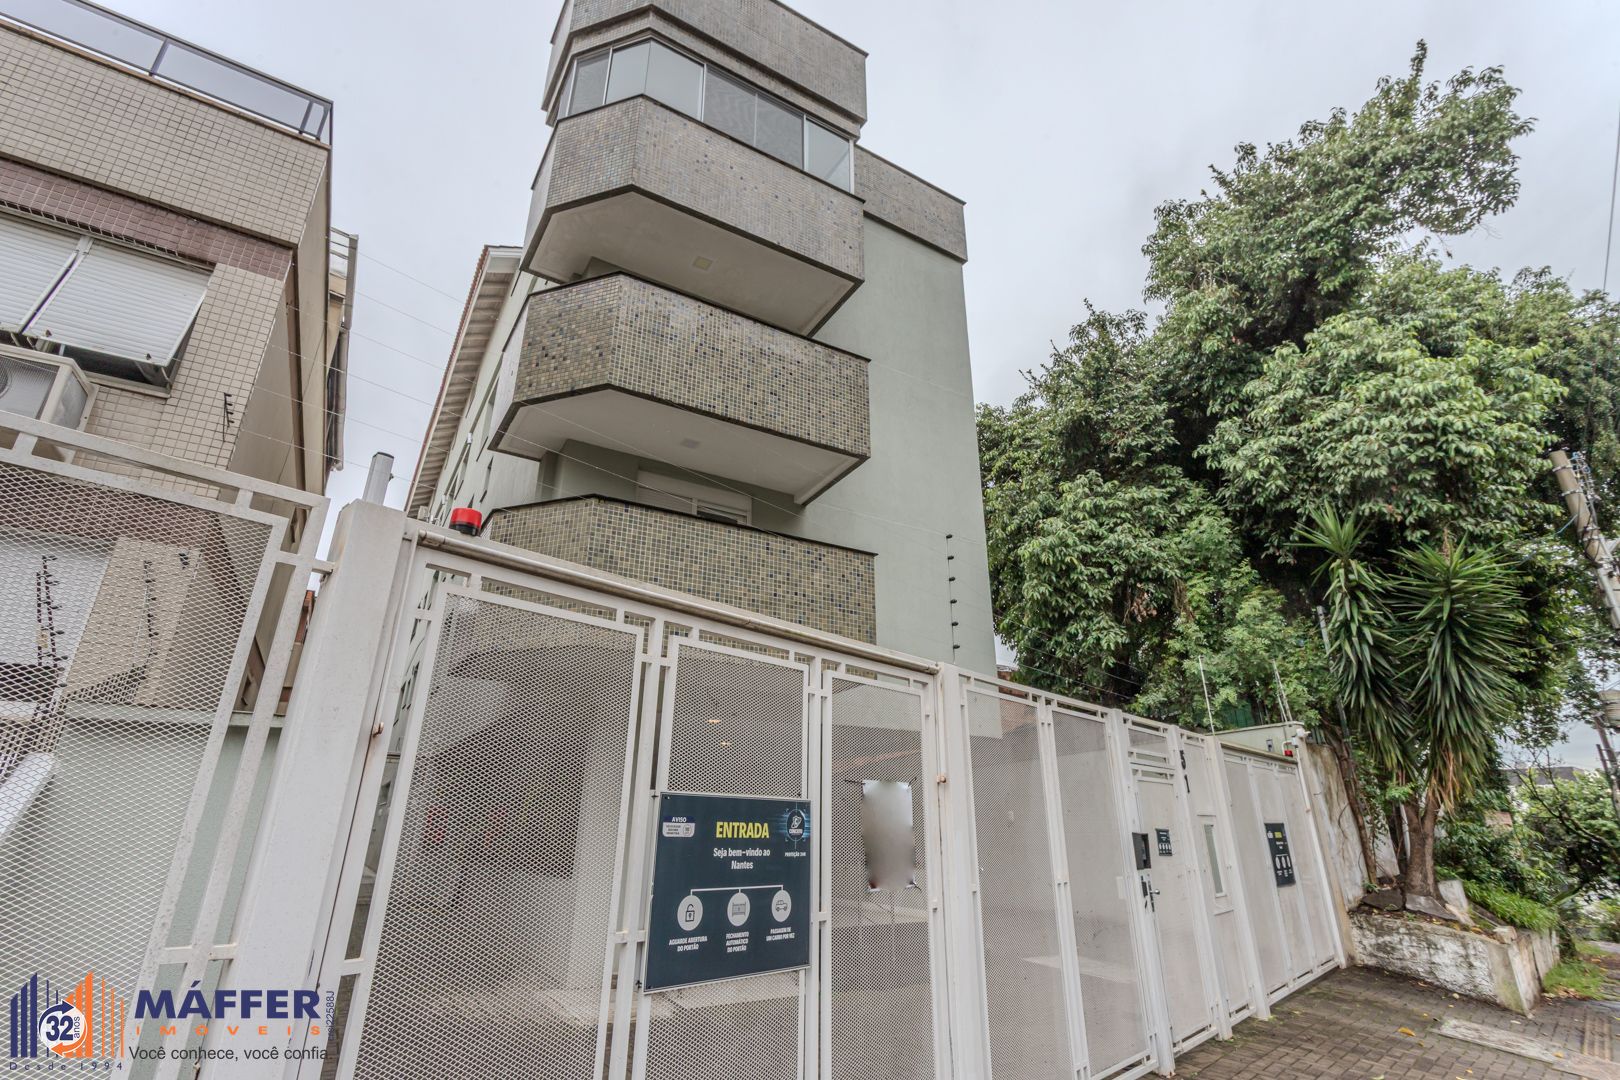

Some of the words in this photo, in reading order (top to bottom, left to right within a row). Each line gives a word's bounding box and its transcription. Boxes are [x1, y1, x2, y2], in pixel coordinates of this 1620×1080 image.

[716, 822, 769, 838] ENTRADA
[714, 848, 727, 858] Seja
[728, 848, 762, 856] bem-vindo
[731, 860, 753, 869] Nantes
